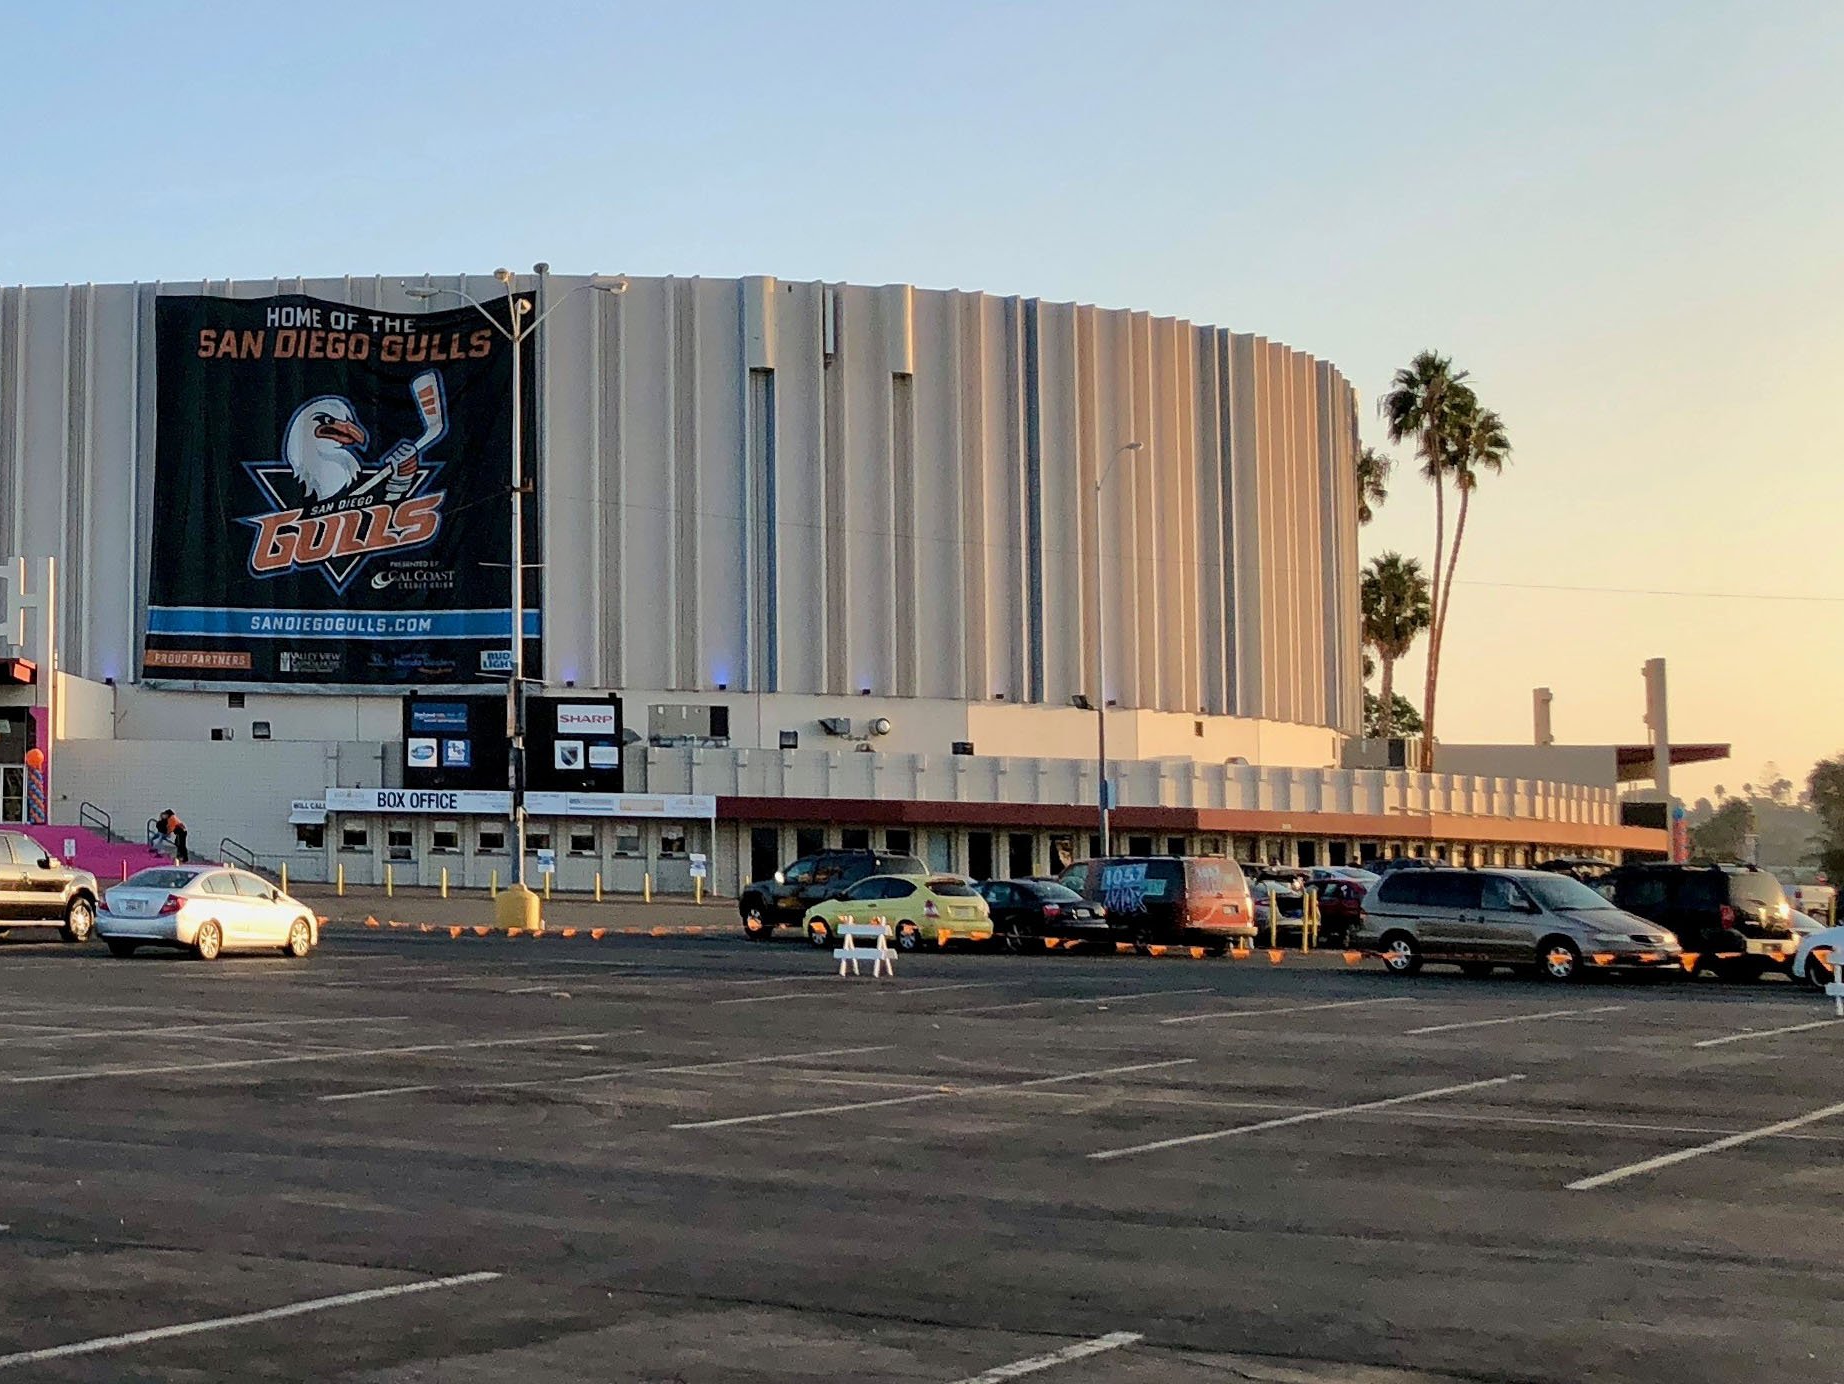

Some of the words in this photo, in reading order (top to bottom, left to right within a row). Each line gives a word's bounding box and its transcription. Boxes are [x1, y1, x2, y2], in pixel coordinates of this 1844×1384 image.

[266, 306, 322, 328] HOME
[330, 311, 360, 330] OF
[368, 315, 416, 333] THE
[197, 329, 265, 359] SAN
[273, 329, 370, 360] DIEGO
[380, 328, 492, 362] GULLS
[310, 502, 334, 515] SAN
[338, 495, 374, 510] DIEGO
[248, 492, 444, 571] GULLS
[414, 570, 455, 581] COAST
[251, 616, 432, 632] SANDIEGOGULLS.COM
[154, 654, 188, 664] PROUD
[192, 654, 246, 666] PARTNERS
[487, 652, 511, 660] BUD
[559, 714, 613, 723] SHARP
[377, 792, 405, 808] BOX
[410, 792, 458, 809] OFFICE
